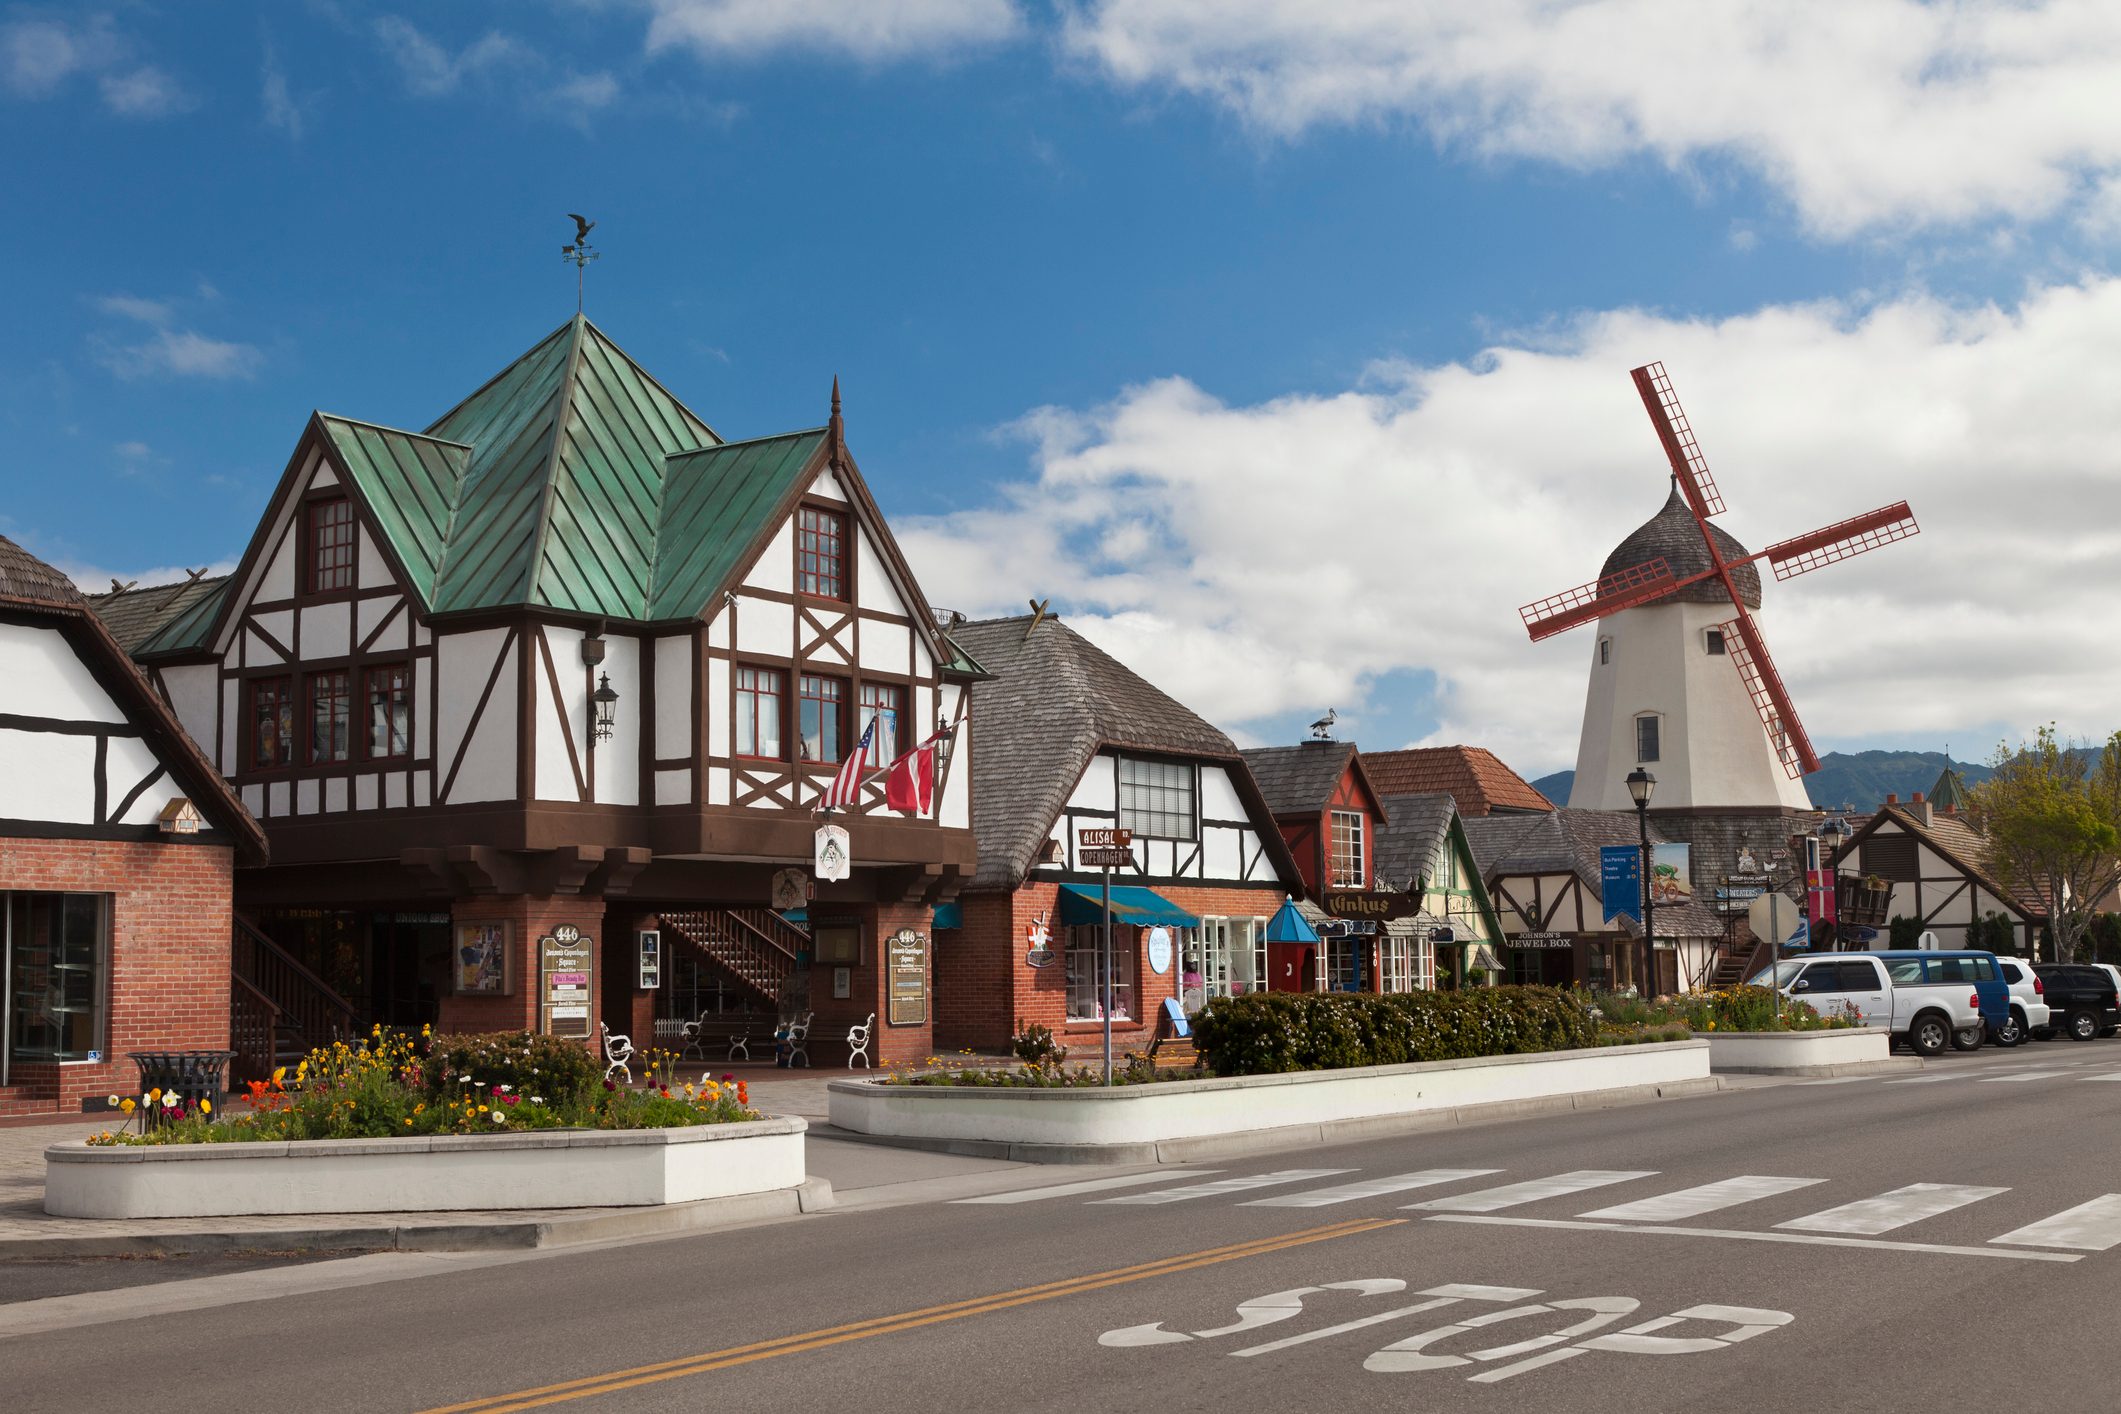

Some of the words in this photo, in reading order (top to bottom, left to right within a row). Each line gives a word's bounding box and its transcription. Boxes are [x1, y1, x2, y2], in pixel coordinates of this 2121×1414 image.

[1083, 831, 1115, 844] ALISAL
[1080, 851, 1123, 864] COPENHAGEN
[1725, 889, 1758, 897] SWEATERS
[1329, 894, 1390, 915] Vinhus
[556, 927, 578, 941] 446
[899, 931, 916, 943] 446
[1508, 939, 1547, 948] JEWEL
[1550, 939, 1571, 948] BOX
[1097, 1277, 1796, 1384] STOP
